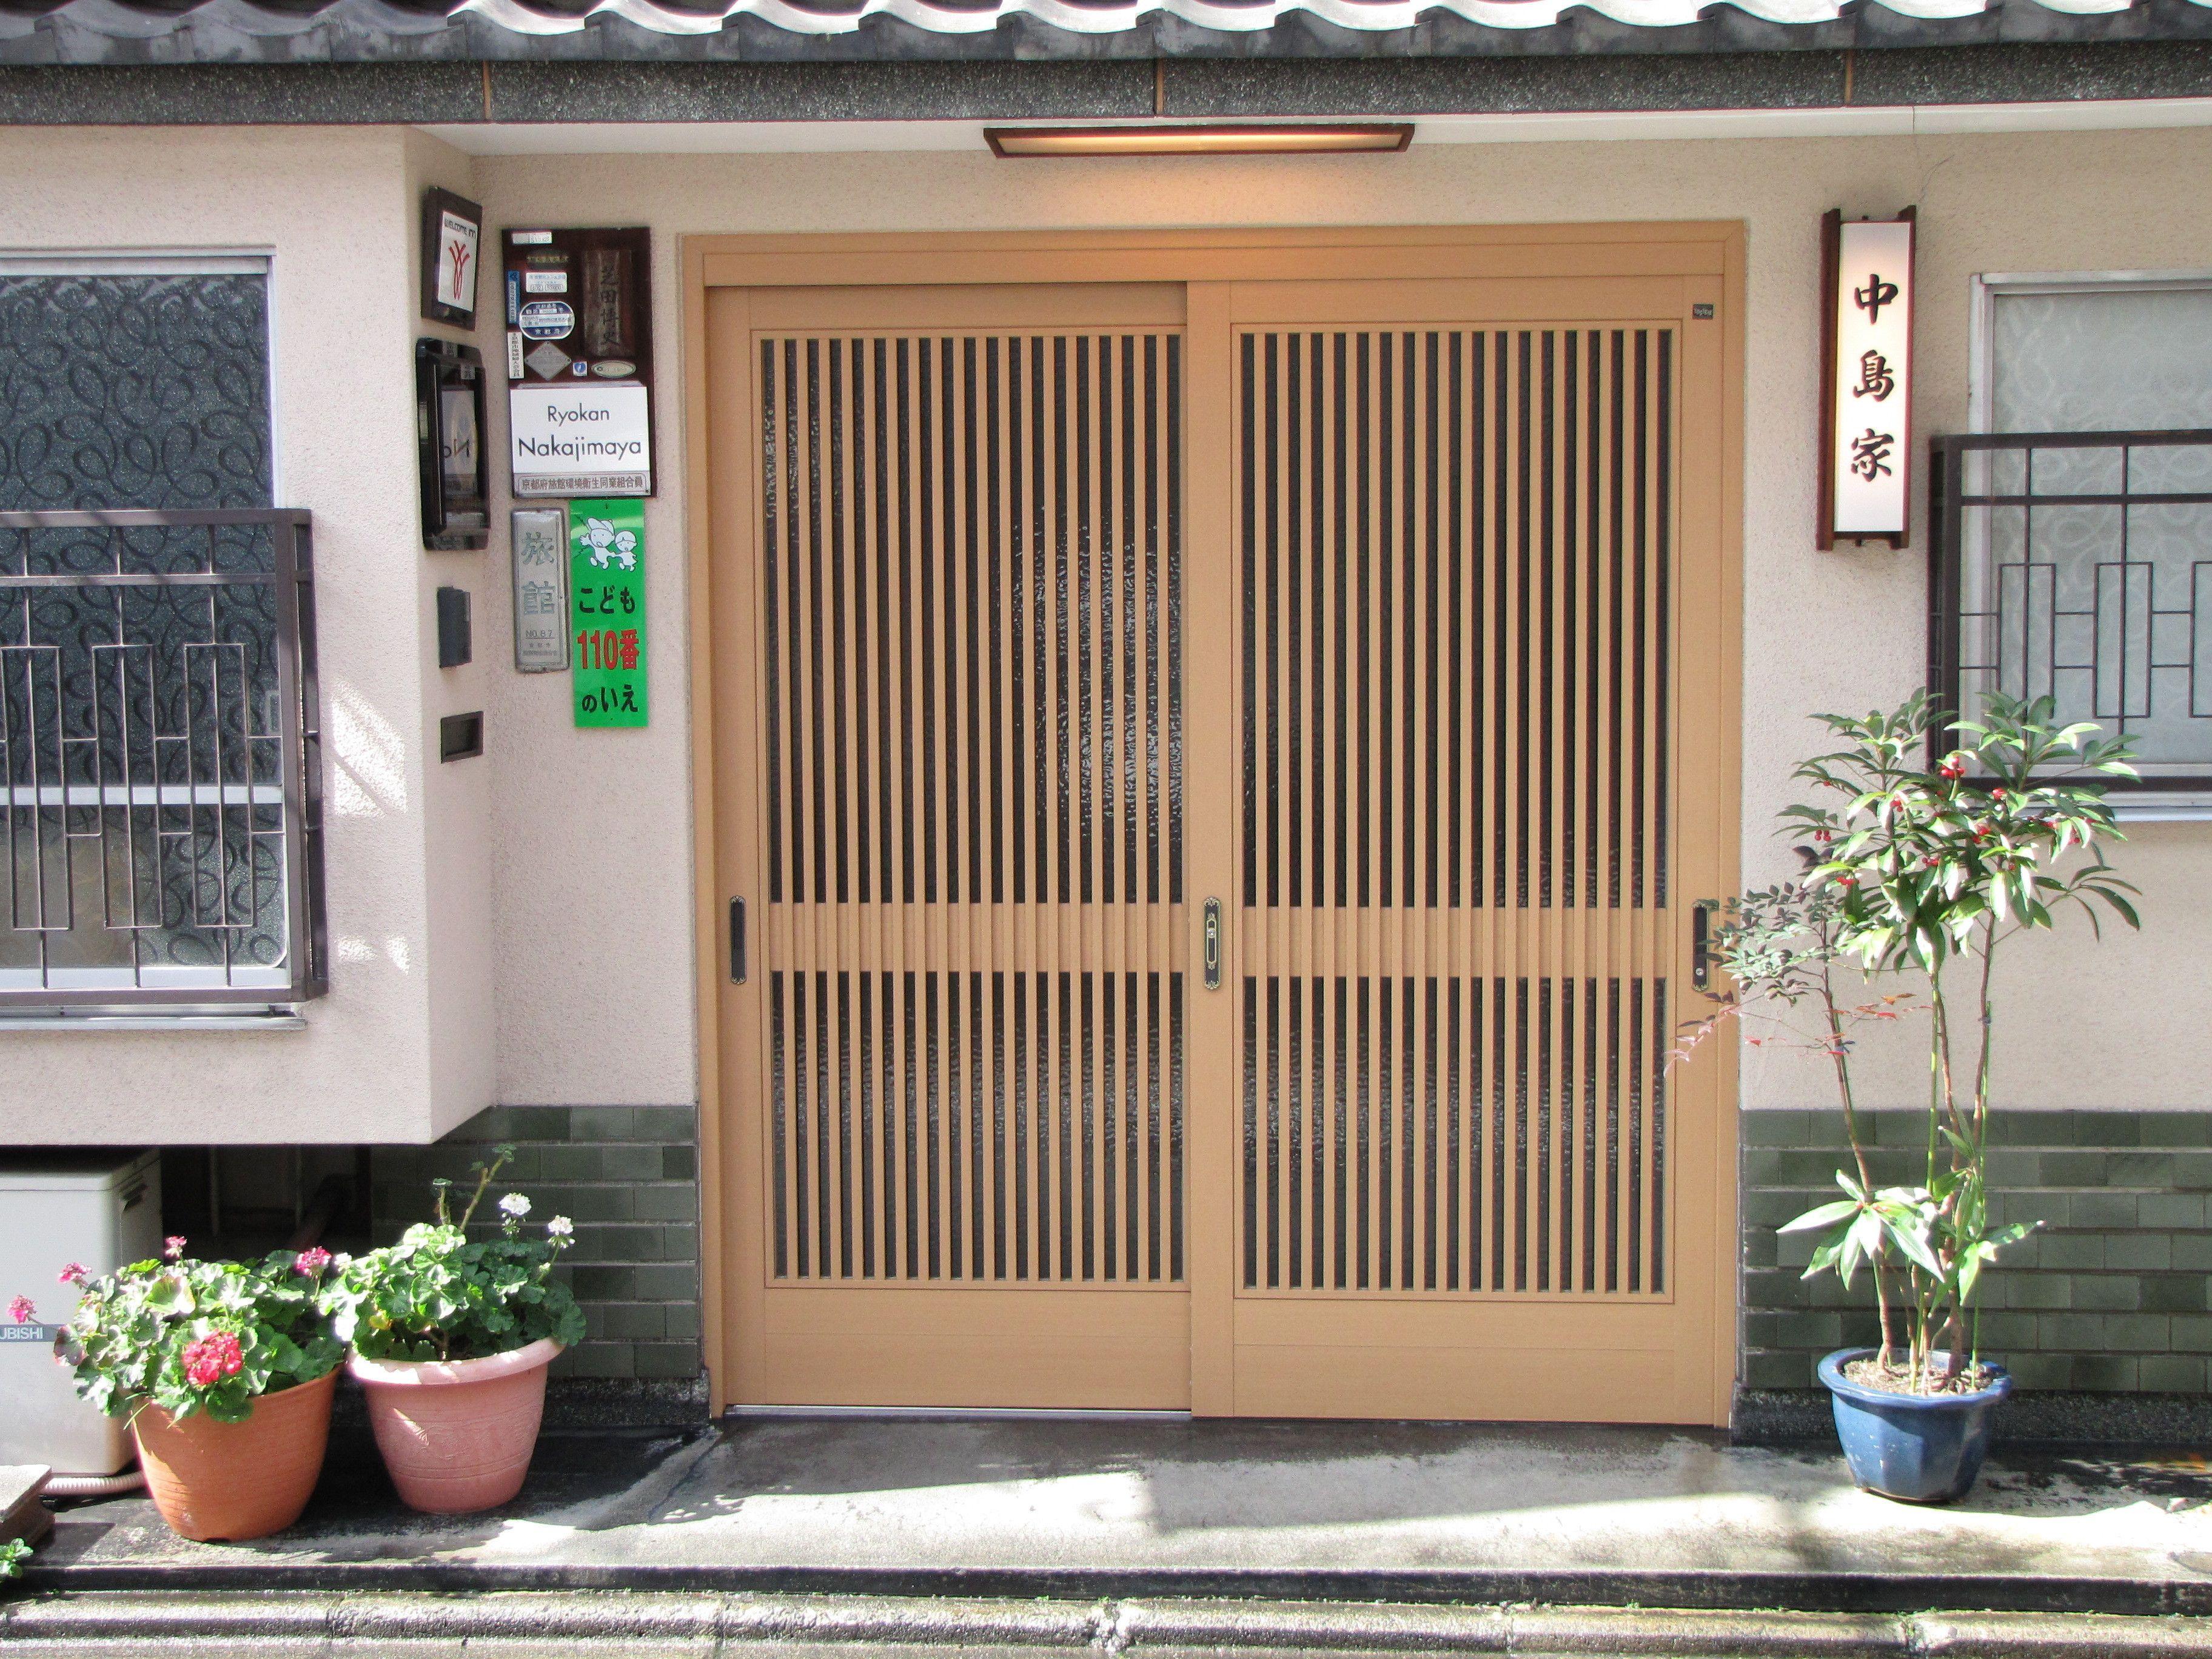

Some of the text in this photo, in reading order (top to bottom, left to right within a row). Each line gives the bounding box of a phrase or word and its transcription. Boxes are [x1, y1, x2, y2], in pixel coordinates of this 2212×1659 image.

[1850, 273, 1899, 483] 中島家
[547, 403, 610, 426] Ryokan
[518, 435, 642, 461] Nakajimaya
[521, 531, 555, 614] 旅館
[578, 586, 636, 614] こども
[577, 628, 640, 670] 110番
[581, 684, 638, 713] のいえ
